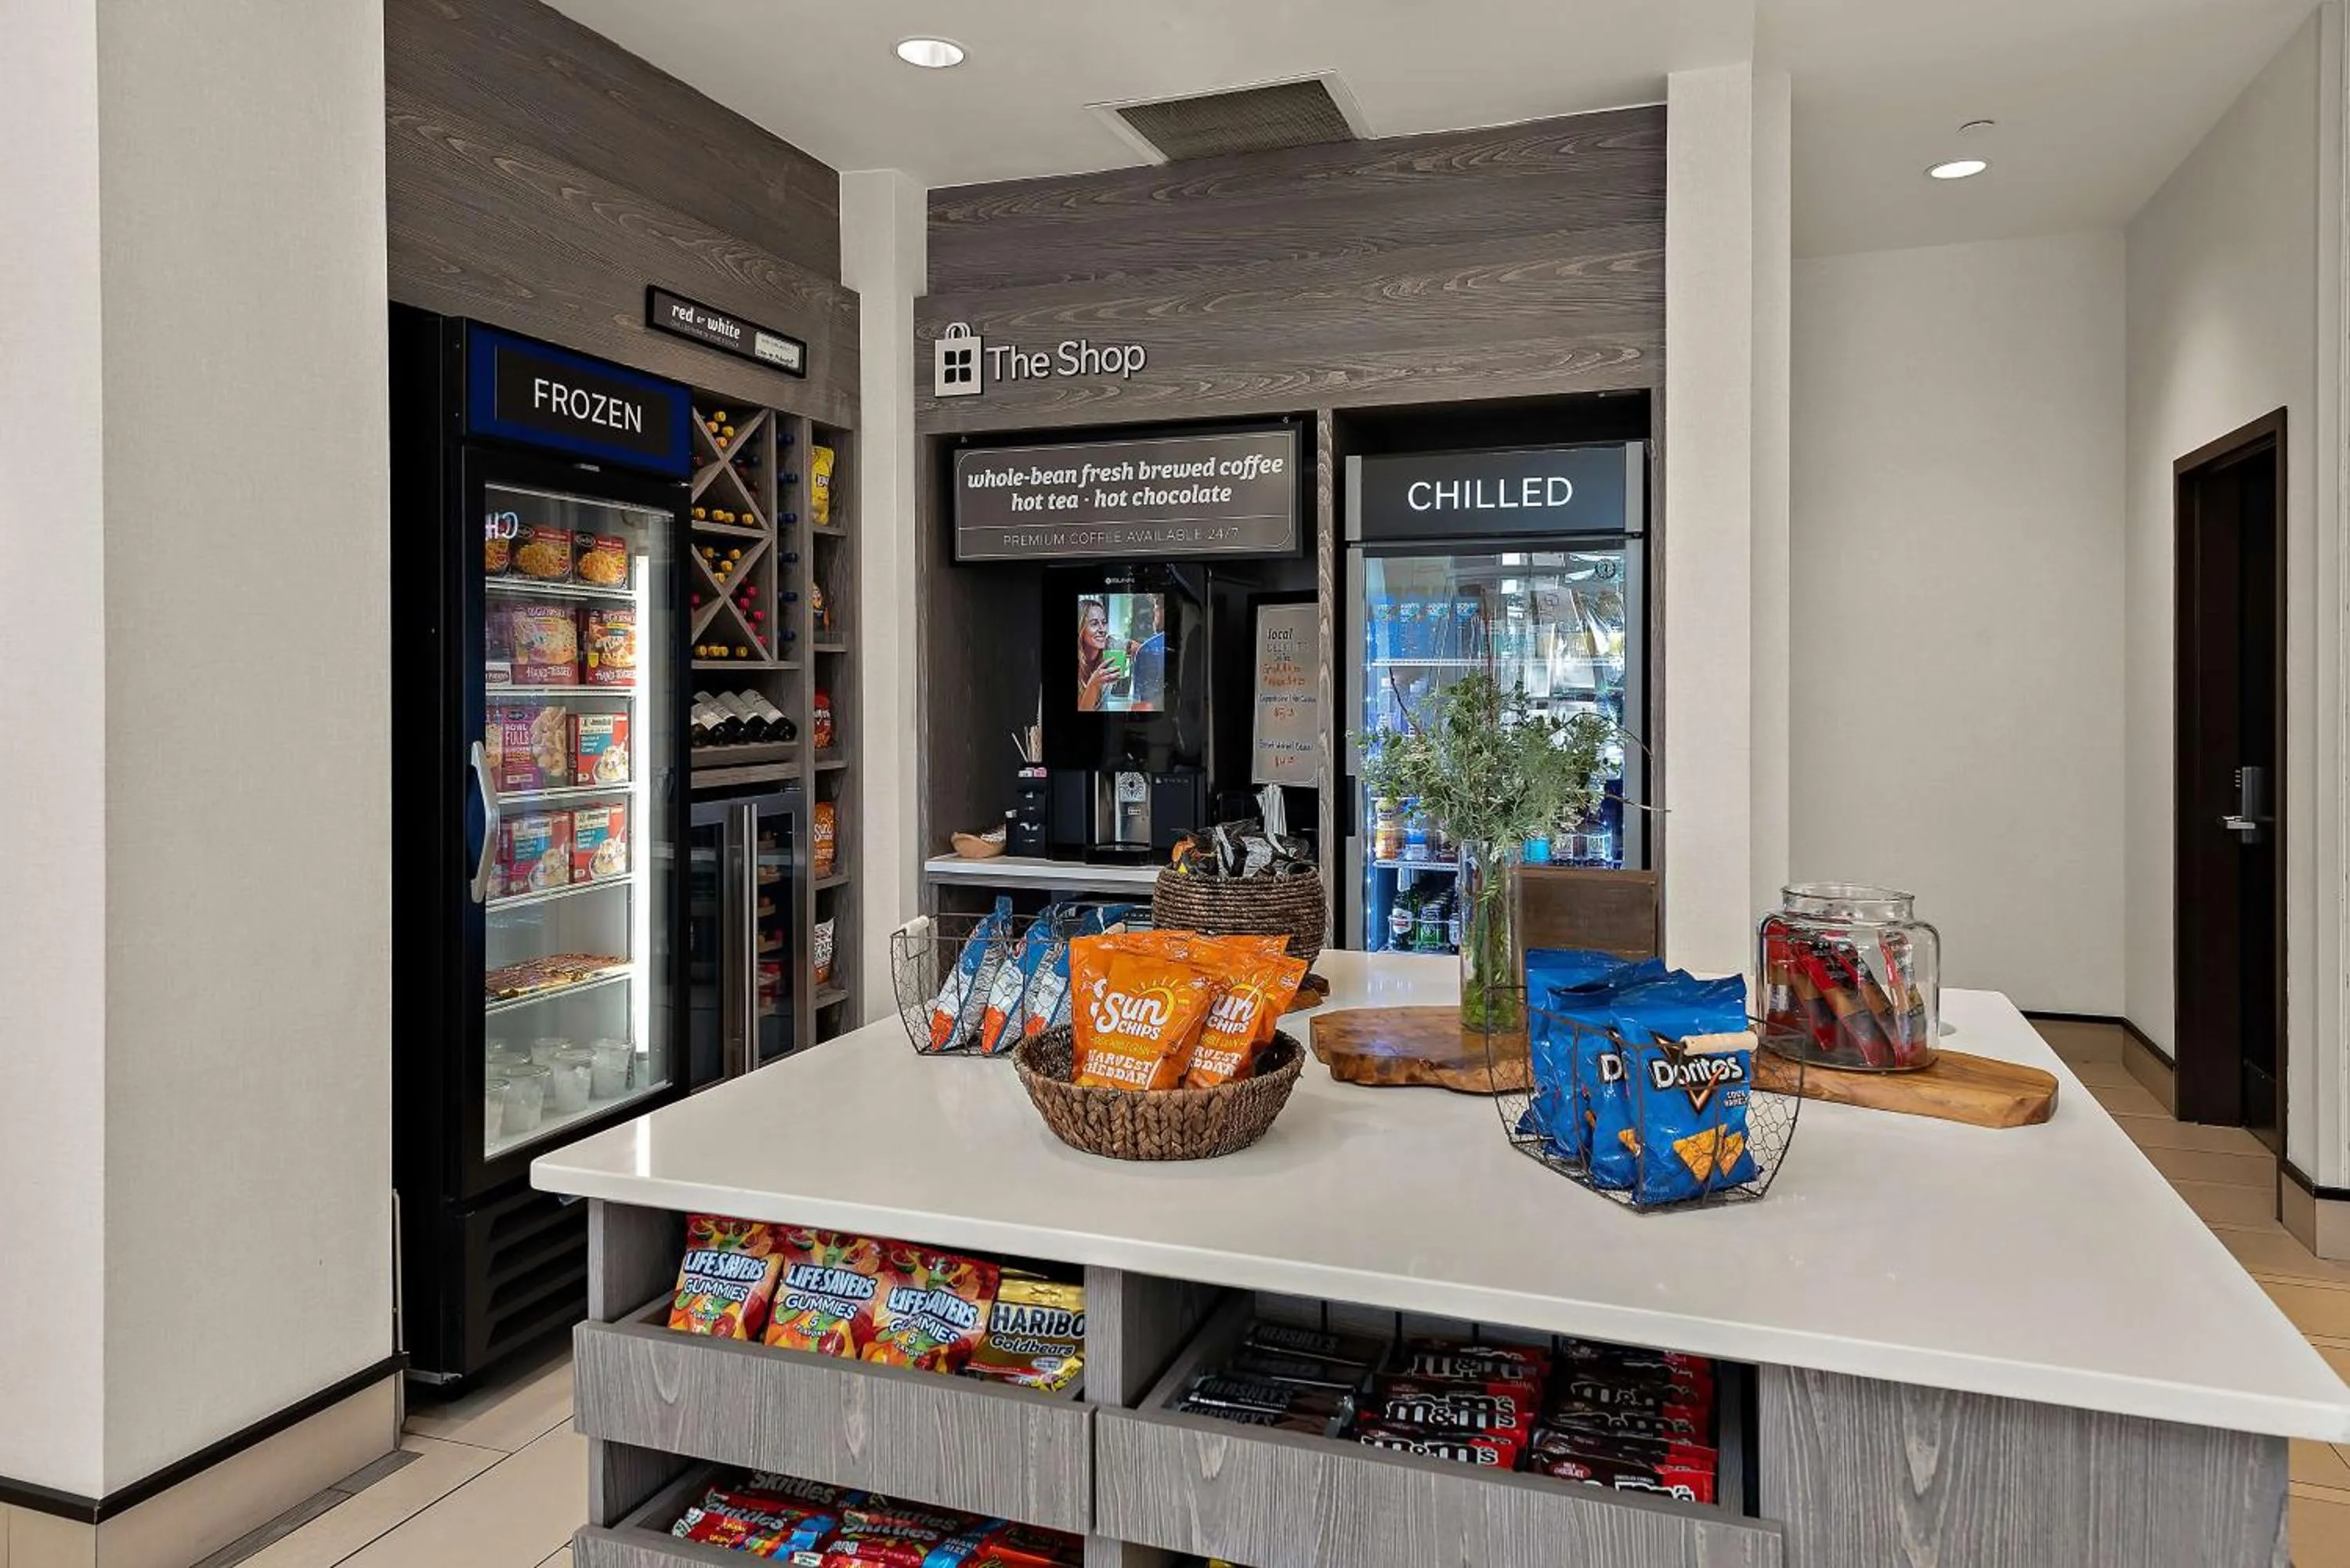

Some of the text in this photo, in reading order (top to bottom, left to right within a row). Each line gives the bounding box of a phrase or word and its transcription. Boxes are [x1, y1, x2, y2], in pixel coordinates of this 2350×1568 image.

[672, 305, 695, 323] red
[707, 317, 740, 339] white
[985, 339, 1147, 381] The Shop
[533, 378, 642, 433] FROZEN
[967, 454, 1284, 489] whole-bean fresh brewed coffee
[1010, 484, 1232, 511] hot tea hot chocolate
[1407, 476, 1574, 511] CHILLED
[1003, 526, 1240, 547] PREMIUM COFFEE AVAILABLE 24/7
[1267, 627, 1293, 640] local
[1095, 992, 1168, 1034] Sun
[1212, 994, 1254, 1022] un
[1116, 1018, 1163, 1041] CHIPS
[1206, 1015, 1249, 1035] CHIPS
[1087, 1049, 1153, 1073] HARVEST
[1194, 1046, 1242, 1065] RVEST
[1651, 1057, 1744, 1088] Doritos
[684, 1279, 748, 1302] GUMMIES
[786, 1295, 859, 1320] GUMMIES
[992, 1302, 1084, 1339] HARIBO
[809, 1317, 819, 1327] 5
[908, 1331, 917, 1344] 5
[990, 1335, 1076, 1357] Goldbears
[750, 1471, 836, 1505] Skittles
